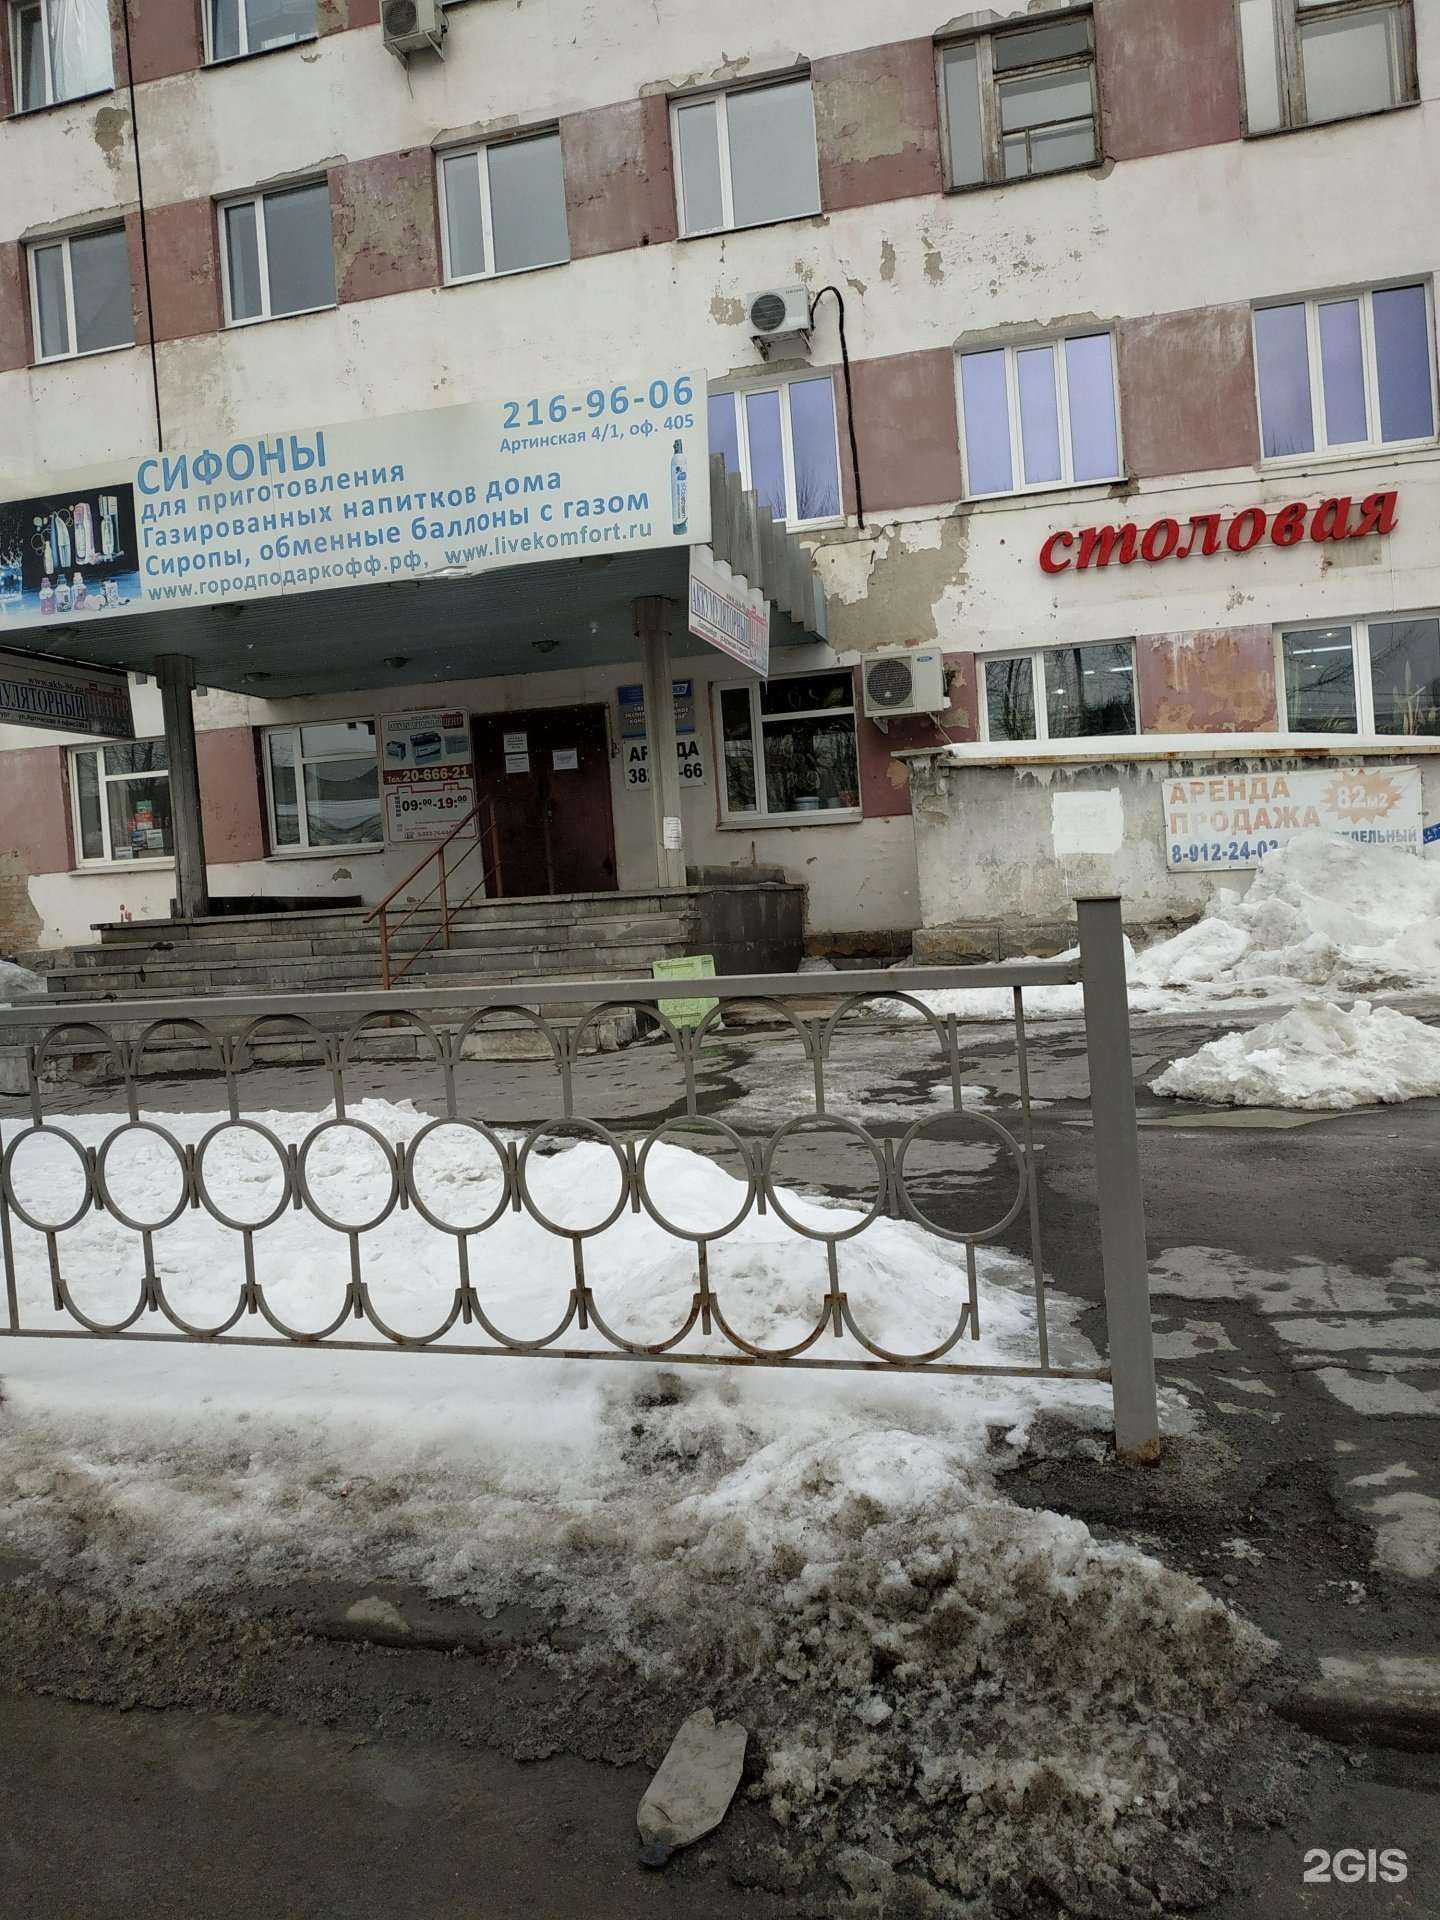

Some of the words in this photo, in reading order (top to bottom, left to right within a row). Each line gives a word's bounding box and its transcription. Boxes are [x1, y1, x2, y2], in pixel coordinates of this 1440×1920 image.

[503, 376, 694, 429] 216-96-06
[500, 429, 586, 454] Артинская
[592, 423, 625, 442] 4/1,
[630, 419, 659, 438] оф.
[663, 413, 694, 431] 405
[137, 431, 326, 495] СИФОНЫ
[141, 498, 187, 524] для
[198, 464, 404, 513] приготовления
[143, 504, 332, 548] Газированных
[344, 486, 476, 519] напитков
[486, 471, 561, 502] дома
[145, 548, 250, 577] Сиропы,
[259, 526, 400, 561] обменные
[411, 507, 529, 541] баллоны
[540, 503, 553, 522] с
[563, 492, 649, 519] газом
[445, 521, 652, 564] www.livekomfort.ru
[1039, 490, 1400, 573] столовая
[402, 766, 469, 783] 20-666-21
[1170, 775, 1291, 804] АРЕНДА
